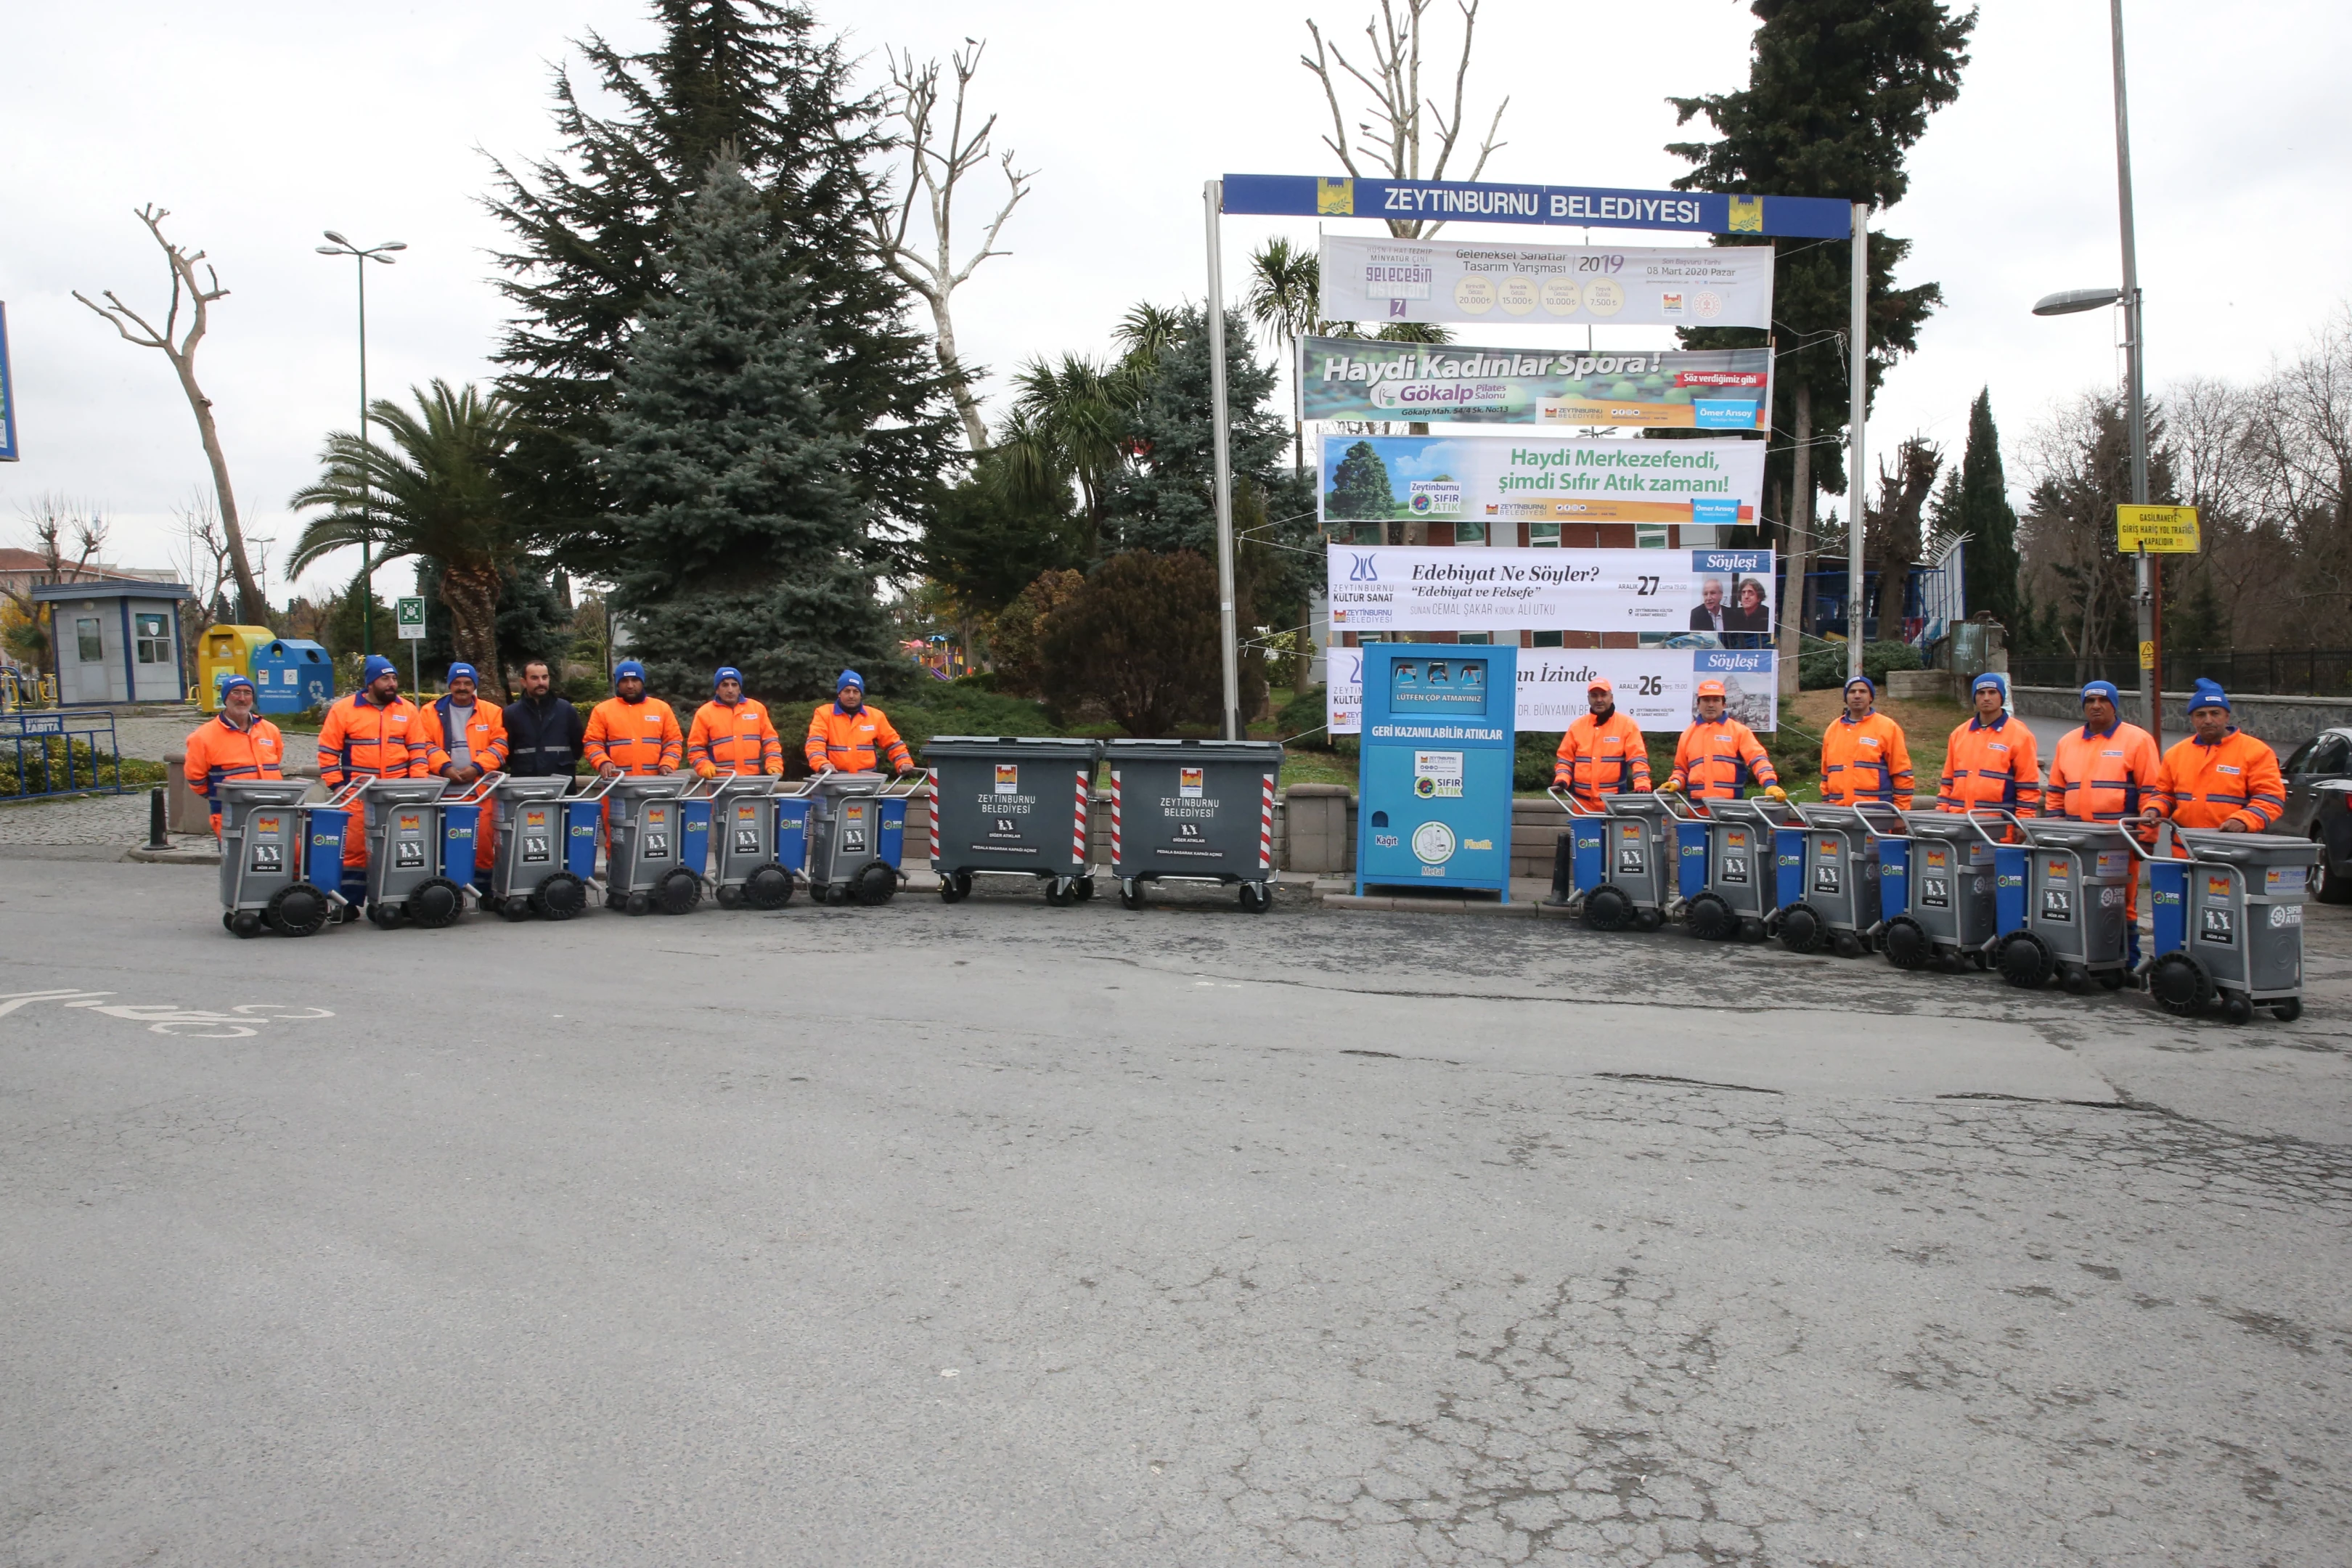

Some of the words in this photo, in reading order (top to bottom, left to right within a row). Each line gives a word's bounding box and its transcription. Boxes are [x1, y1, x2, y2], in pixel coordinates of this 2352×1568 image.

[1456, 249, 1516, 260] Geleneksel
[1520, 251, 1567, 261] Sanatlar
[1463, 261, 1508, 271] Tasarım
[1513, 262, 1566, 275] Yarışması
[1579, 254, 1625, 274] 2019
[1662, 266, 1682, 275] Mart
[1685, 267, 1707, 276] 2020
[1711, 268, 1736, 277] Pazar
[1394, 299, 1403, 313] 7
[1323, 354, 1416, 387] Haydi
[1420, 353, 1554, 378] Kadınlar
[1683, 372, 1698, 383] Söz
[1699, 373, 1740, 384] verdiğimiz
[1741, 375, 1757, 385] gibi
[1400, 383, 1474, 404] Gökalp
[1402, 408, 1430, 417] Gökalp
[1699, 407, 1724, 417] Ömer
[1726, 409, 1752, 418] Arısoy
[1511, 448, 1571, 470] Haydi
[1575, 449, 1720, 471] Merkezefendi,
[1411, 483, 1460, 494] Zeytinburnu
[1498, 473, 1555, 494] şimdi
[1559, 473, 1600, 490] Sıfır
[1604, 473, 1645, 491] Atık
[1649, 475, 1729, 493] zamanı!
[1434, 503, 1459, 512] ATIK
[1707, 555, 1757, 571] Söyleşi
[1411, 563, 1496, 585] Edebiyat
[1499, 565, 1524, 581] Ne
[1528, 564, 1600, 585] Söyler?
[1638, 576, 1659, 595] 27
[1334, 592, 1364, 602] KÜLTÜR
[1367, 592, 1394, 602] SANAT
[1476, 589, 1489, 597] ve
[1410, 606, 1431, 615] SUNAN
[1432, 603, 1461, 615] CEMAL
[1463, 603, 1493, 617] ŞAKAR
[1495, 606, 1515, 616] KONUK
[1517, 602, 1531, 616] ALİ
[1533, 603, 1555, 616] UTKU
[1707, 653, 1759, 671] Söyleşi
[1539, 662, 1597, 682] İzinde
[1639, 675, 1662, 695] 26
[1425, 693, 1440, 702] ÇÖP
[1518, 704, 1530, 716] DR.
[1534, 703, 1577, 716] BÜNYAMİN
[1372, 723, 1393, 738] GERİ
[1395, 724, 1463, 739] KAZANILABİLİR
[1464, 728, 1503, 740] ATIKLAR
[978, 793, 1036, 804] ZEYTİNBURNU
[1160, 797, 1220, 808] ZEYTİNBURNU
[981, 804, 1031, 814] BELEDİYESİ
[1164, 807, 1214, 817] BELEDİYESİ
[1376, 836, 1398, 847] Kağıt
[1464, 839, 1493, 850] Plastik
[1421, 866, 1445, 876] Metal
